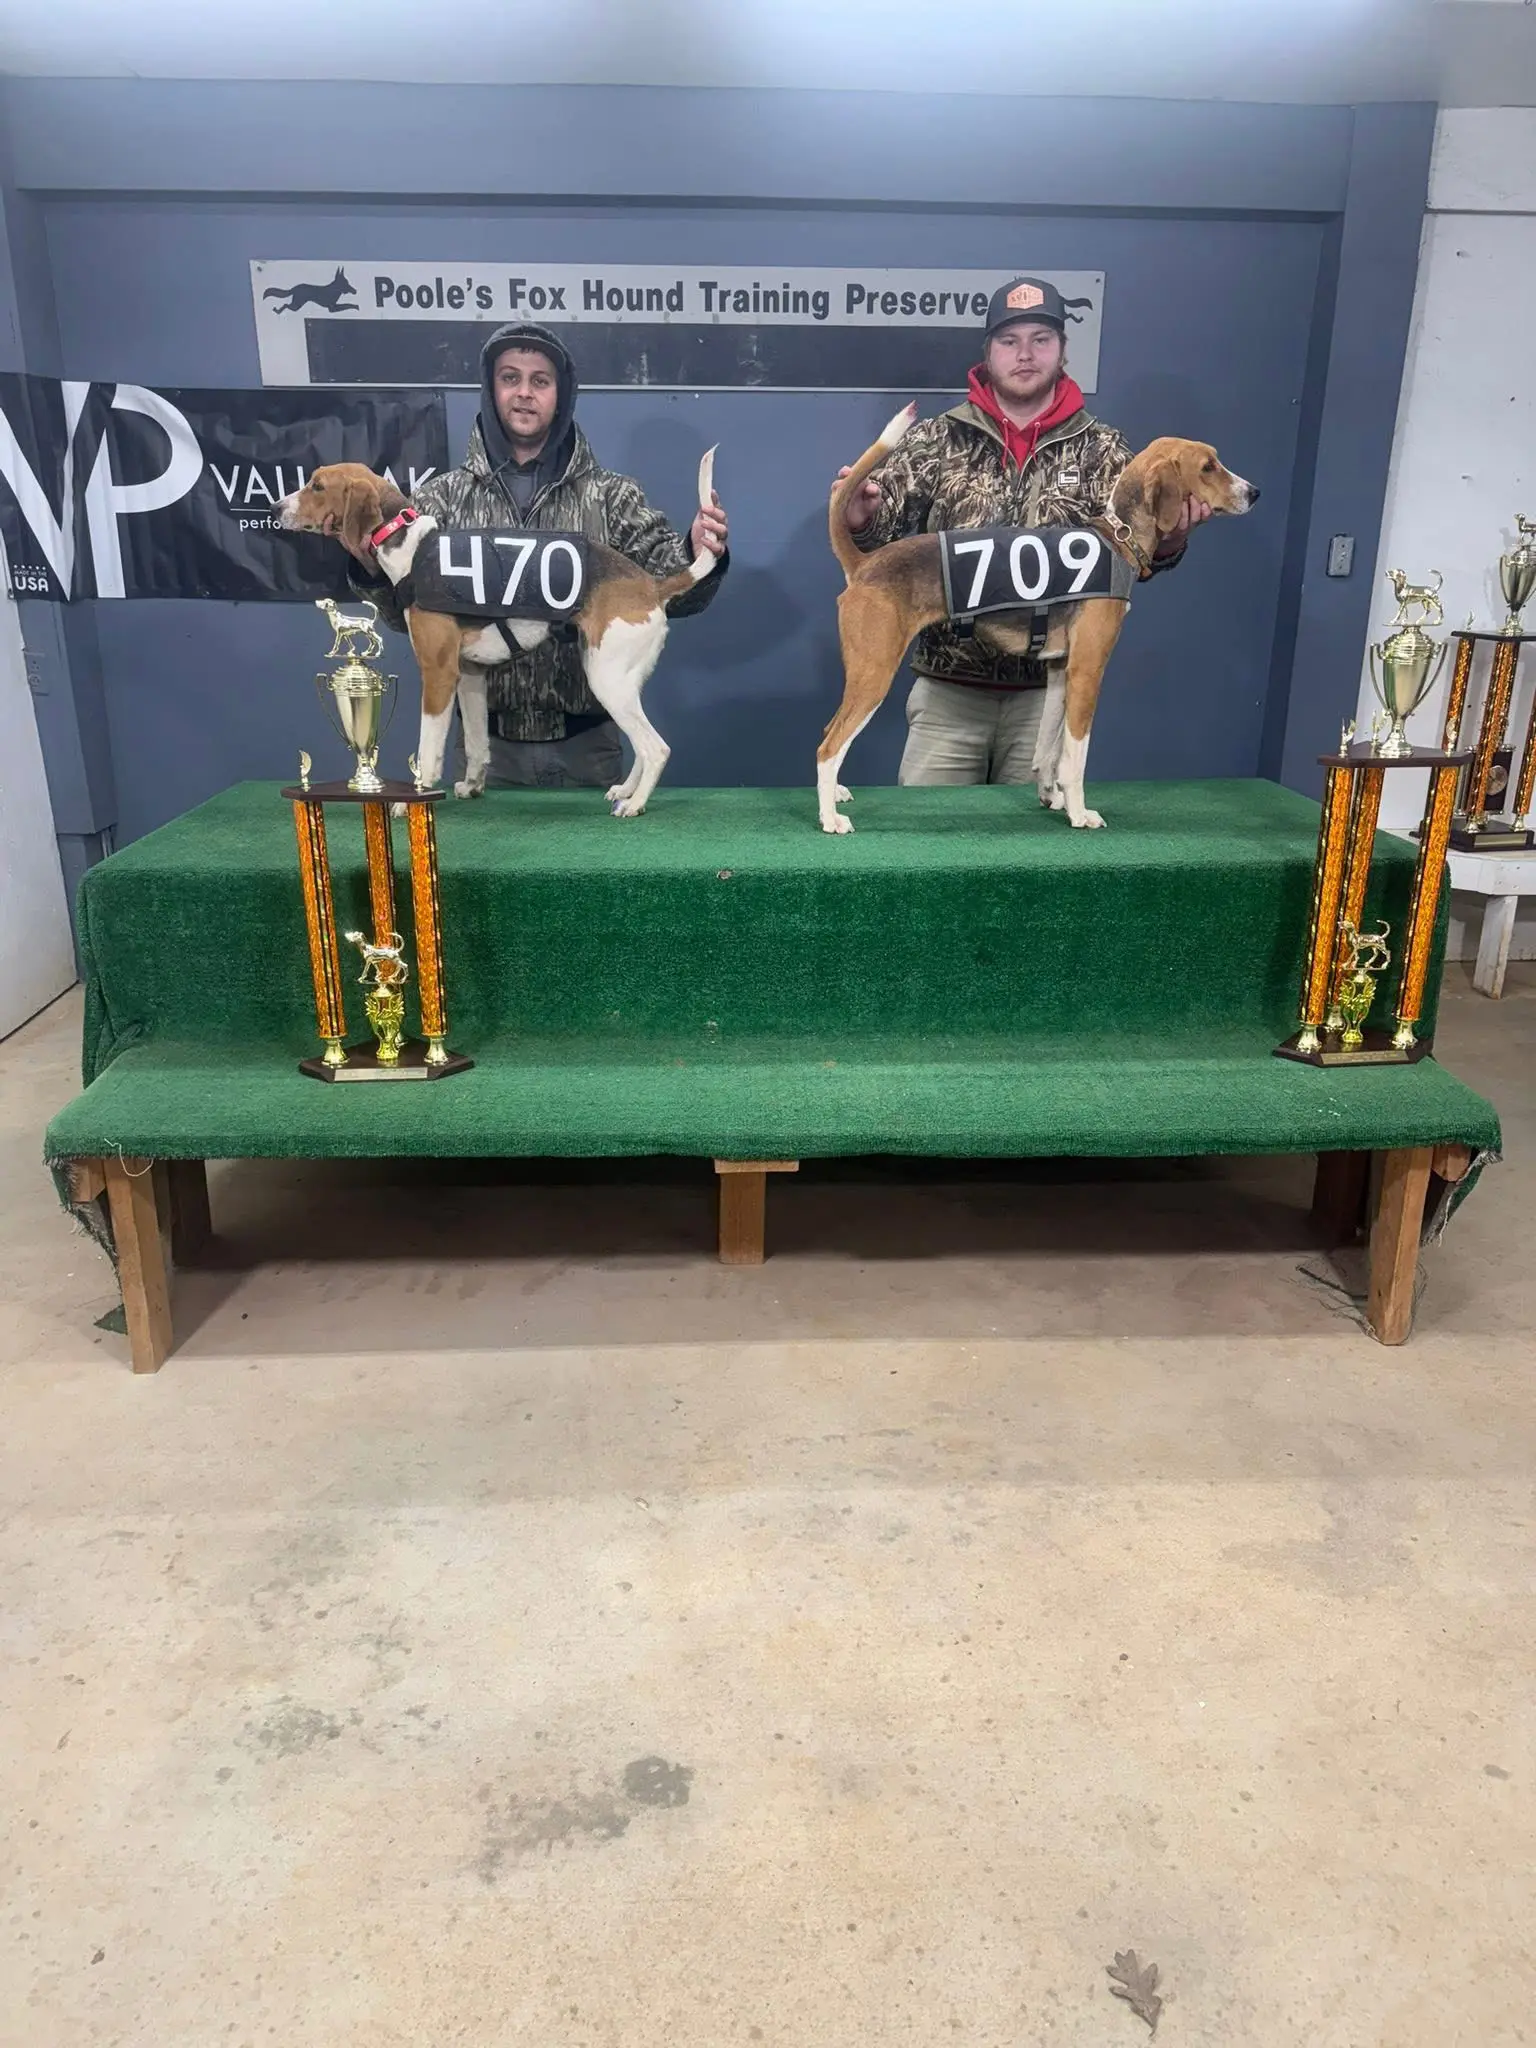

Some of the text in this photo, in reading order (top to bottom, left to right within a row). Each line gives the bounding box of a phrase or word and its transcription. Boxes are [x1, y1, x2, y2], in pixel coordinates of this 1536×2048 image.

[374, 276, 988, 320] Poole's Fox Hound Training Preserve
[14, 576, 49, 592] USA
[439, 535, 583, 610] 470
[954, 531, 1101, 609] 709
